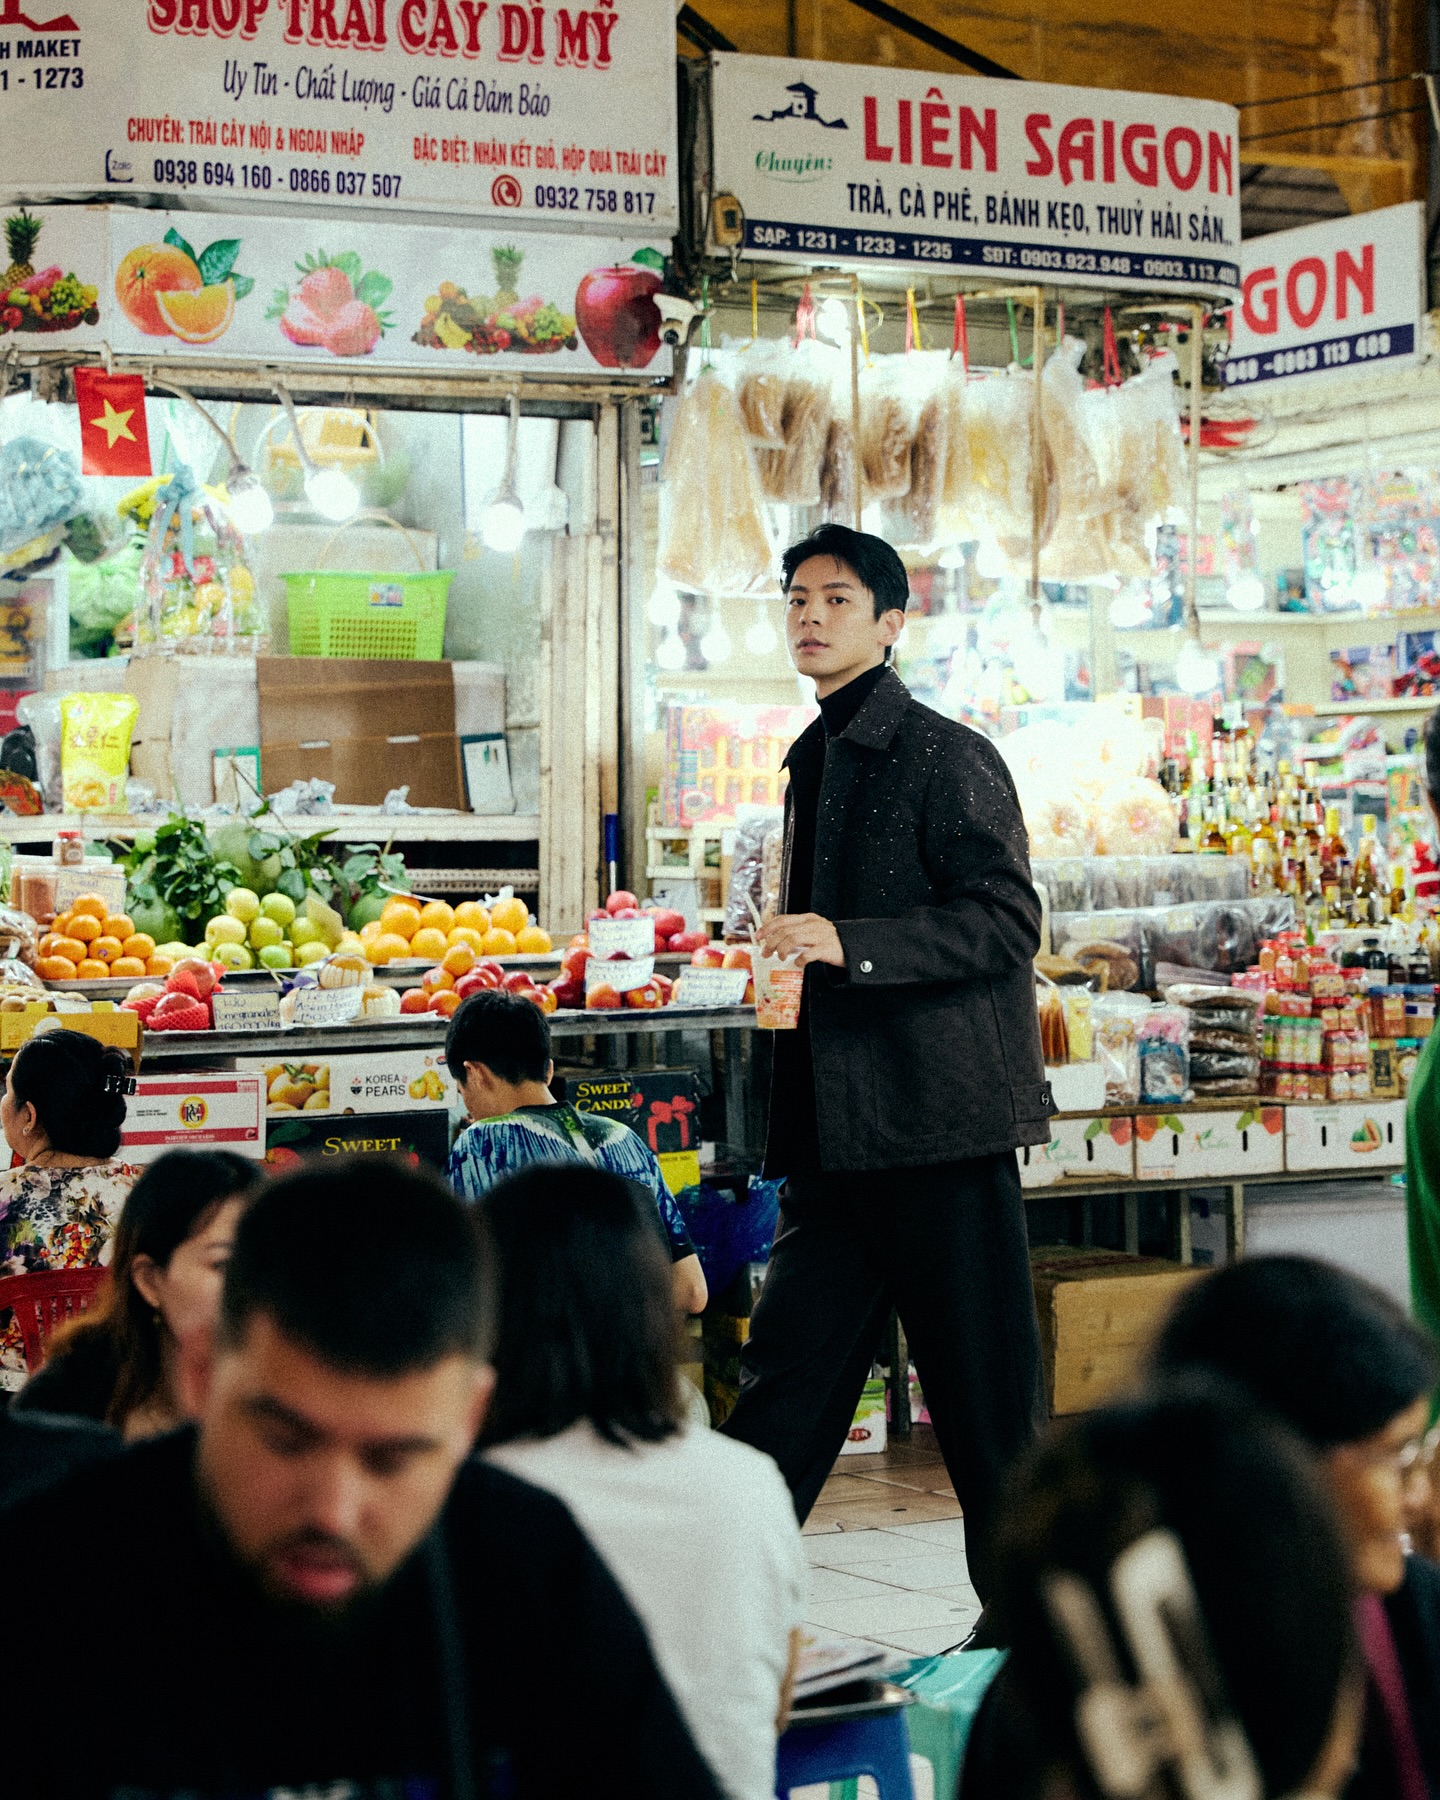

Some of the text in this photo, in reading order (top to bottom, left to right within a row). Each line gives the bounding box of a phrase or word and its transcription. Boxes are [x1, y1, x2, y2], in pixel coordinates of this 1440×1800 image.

[17, 39, 81, 58] MAKET
[33, 67, 84, 89] 1273
[224, 60, 247, 101] Uy
[295, 64, 336, 99] Chất
[342, 69, 395, 112] Lượng
[412, 75, 441, 108] Giá
[446, 77, 468, 110] Cả
[473, 80, 513, 114] Đảm
[518, 83, 550, 117] Bảo
[127, 113, 184, 143] CHUYÊN:
[188, 116, 217, 145] TRÁI
[221, 118, 245, 147] CÂY
[276, 127, 284, 151] &
[289, 128, 327, 158] NGOẠI
[863, 86, 1234, 198] LIÊN SAIGON
[154, 159, 197, 184] 0938
[204, 162, 235, 186] 694
[242, 165, 271, 190] 160
[290, 168, 330, 193] 0866
[336, 171, 366, 196] 037
[372, 173, 402, 198] 507
[535, 185, 655, 214] 0932 758 817
[847, 178, 892, 218] TRÀ,
[900, 182, 926, 218] CÀ
[934, 186, 979, 226] PHÊ,
[986, 190, 1040, 228] BÁNH
[1047, 201, 1090, 238] KẸO,
[1151, 201, 1182, 241] HẢI
[753, 226, 791, 247] SẠP:
[797, 231, 837, 249] 1231
[855, 235, 896, 255] 1233
[911, 240, 953, 260] 1235
[366, 1074, 400, 1084] KOREA
[366, 1085, 406, 1097] PEARS
